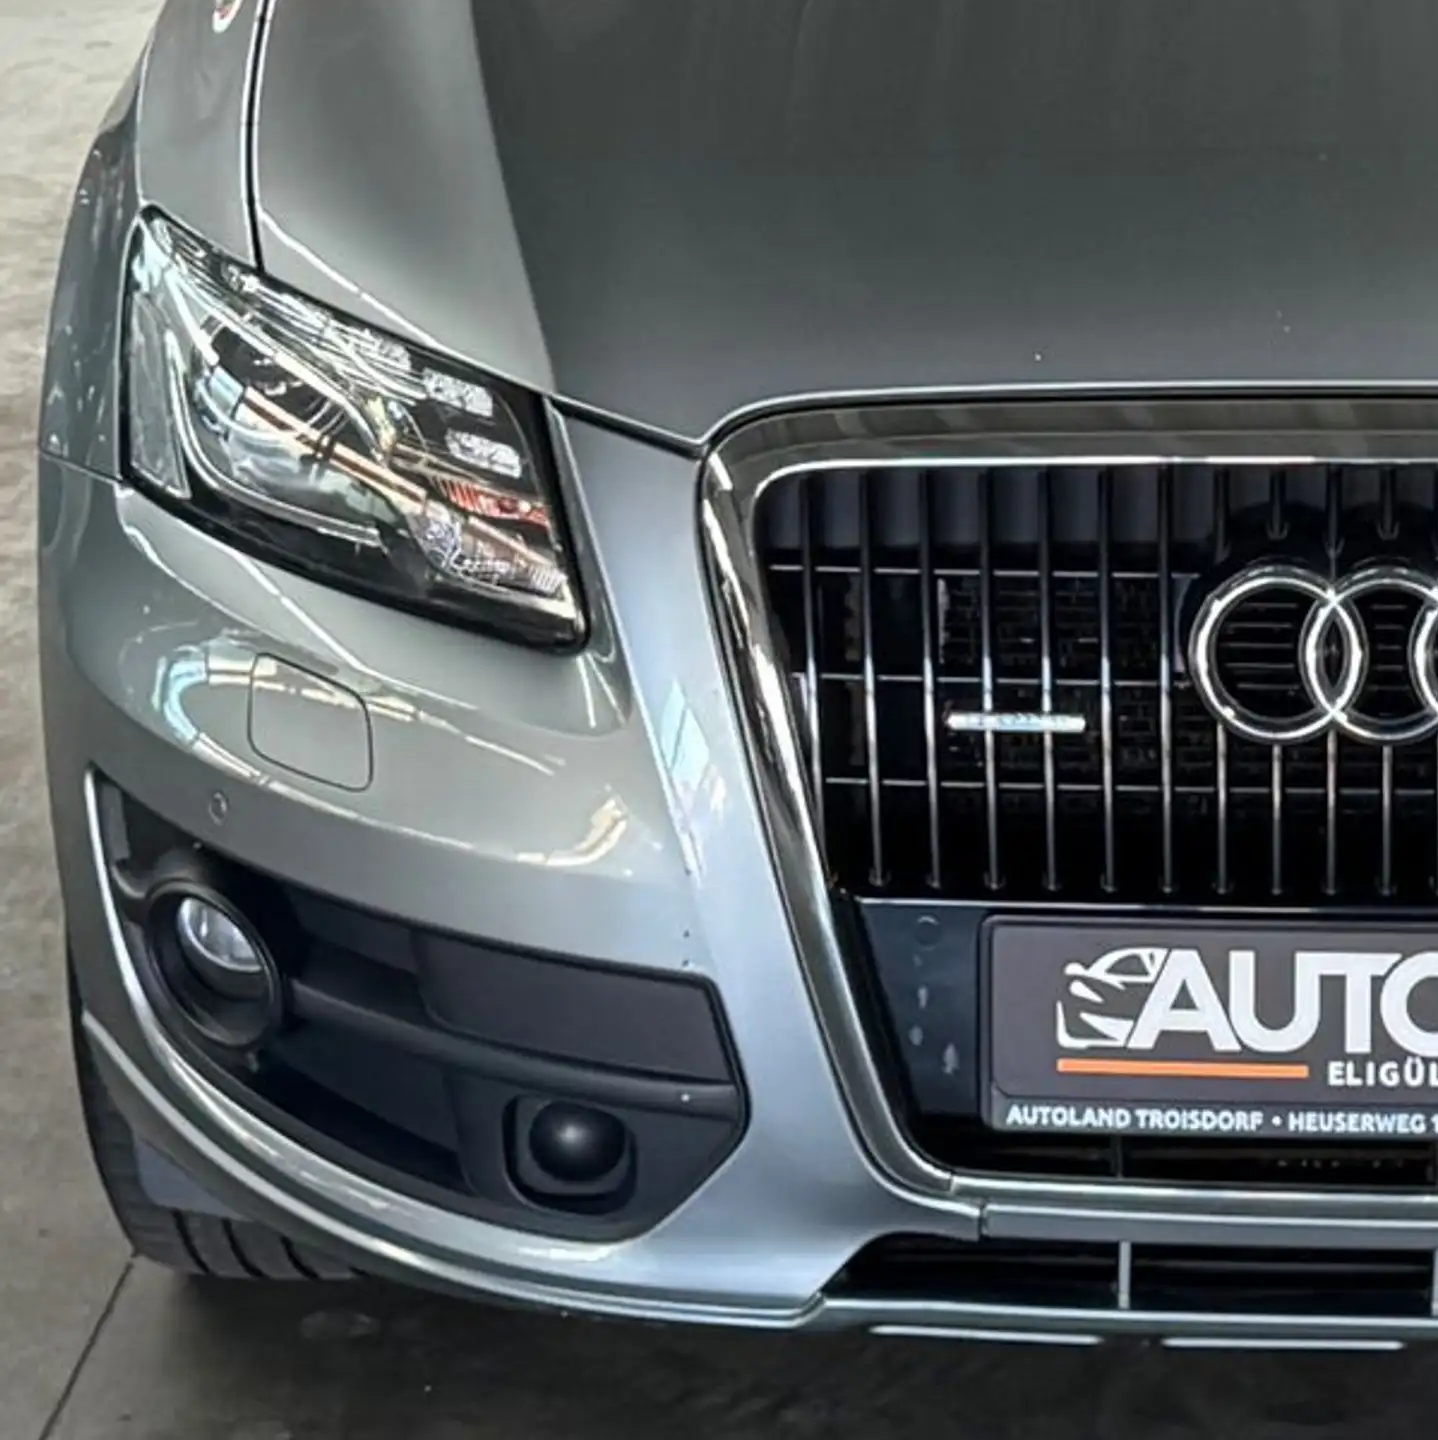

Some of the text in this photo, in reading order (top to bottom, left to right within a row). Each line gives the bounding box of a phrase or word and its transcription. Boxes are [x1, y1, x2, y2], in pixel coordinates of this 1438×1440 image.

[1005, 1104, 1131, 1128] AUTOLAND
[1134, 1108, 1264, 1132] TROISDORF
[1288, 1111, 1427, 1134] HEUSERWEG
